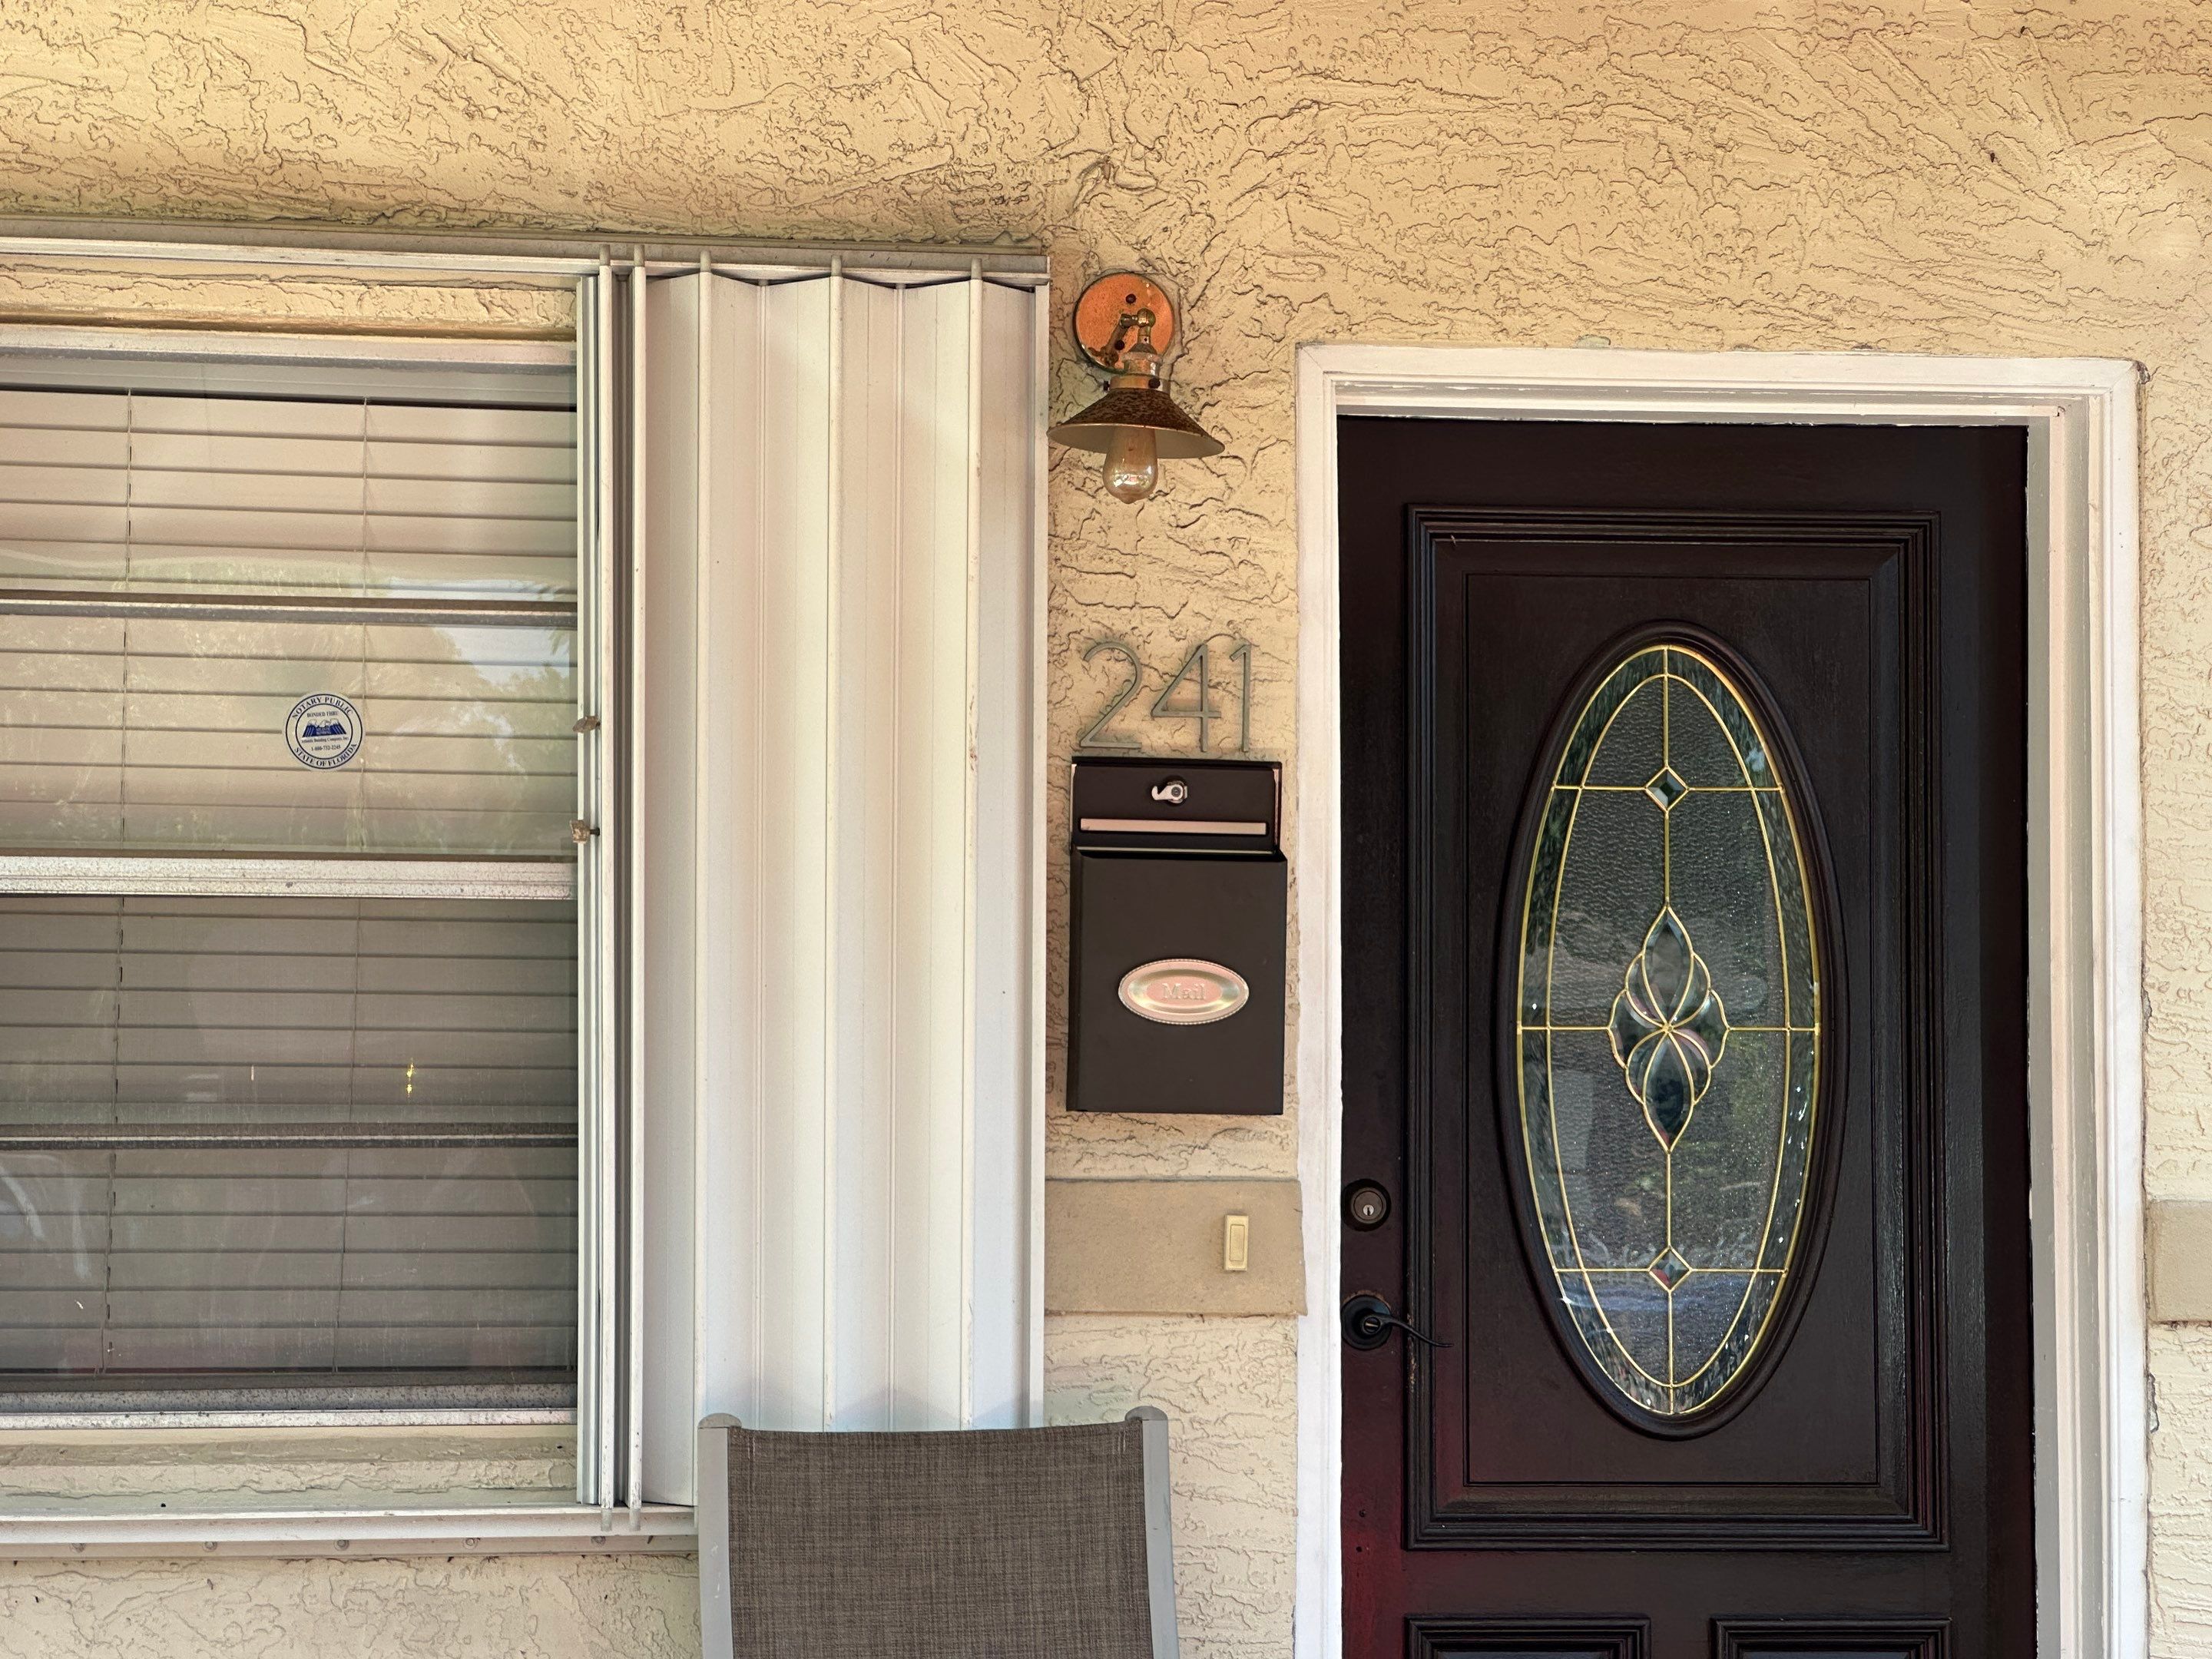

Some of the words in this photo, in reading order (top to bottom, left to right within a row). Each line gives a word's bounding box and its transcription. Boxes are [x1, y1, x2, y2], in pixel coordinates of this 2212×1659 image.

[292, 697, 322, 719] NOTARY
[324, 697, 353, 716] PUBLIC
[1080, 641, 1252, 752] 241
[294, 747, 315, 767] STATE
[328, 743, 357, 767] FLORIDA
[1162, 982, 1206, 999] Mail
